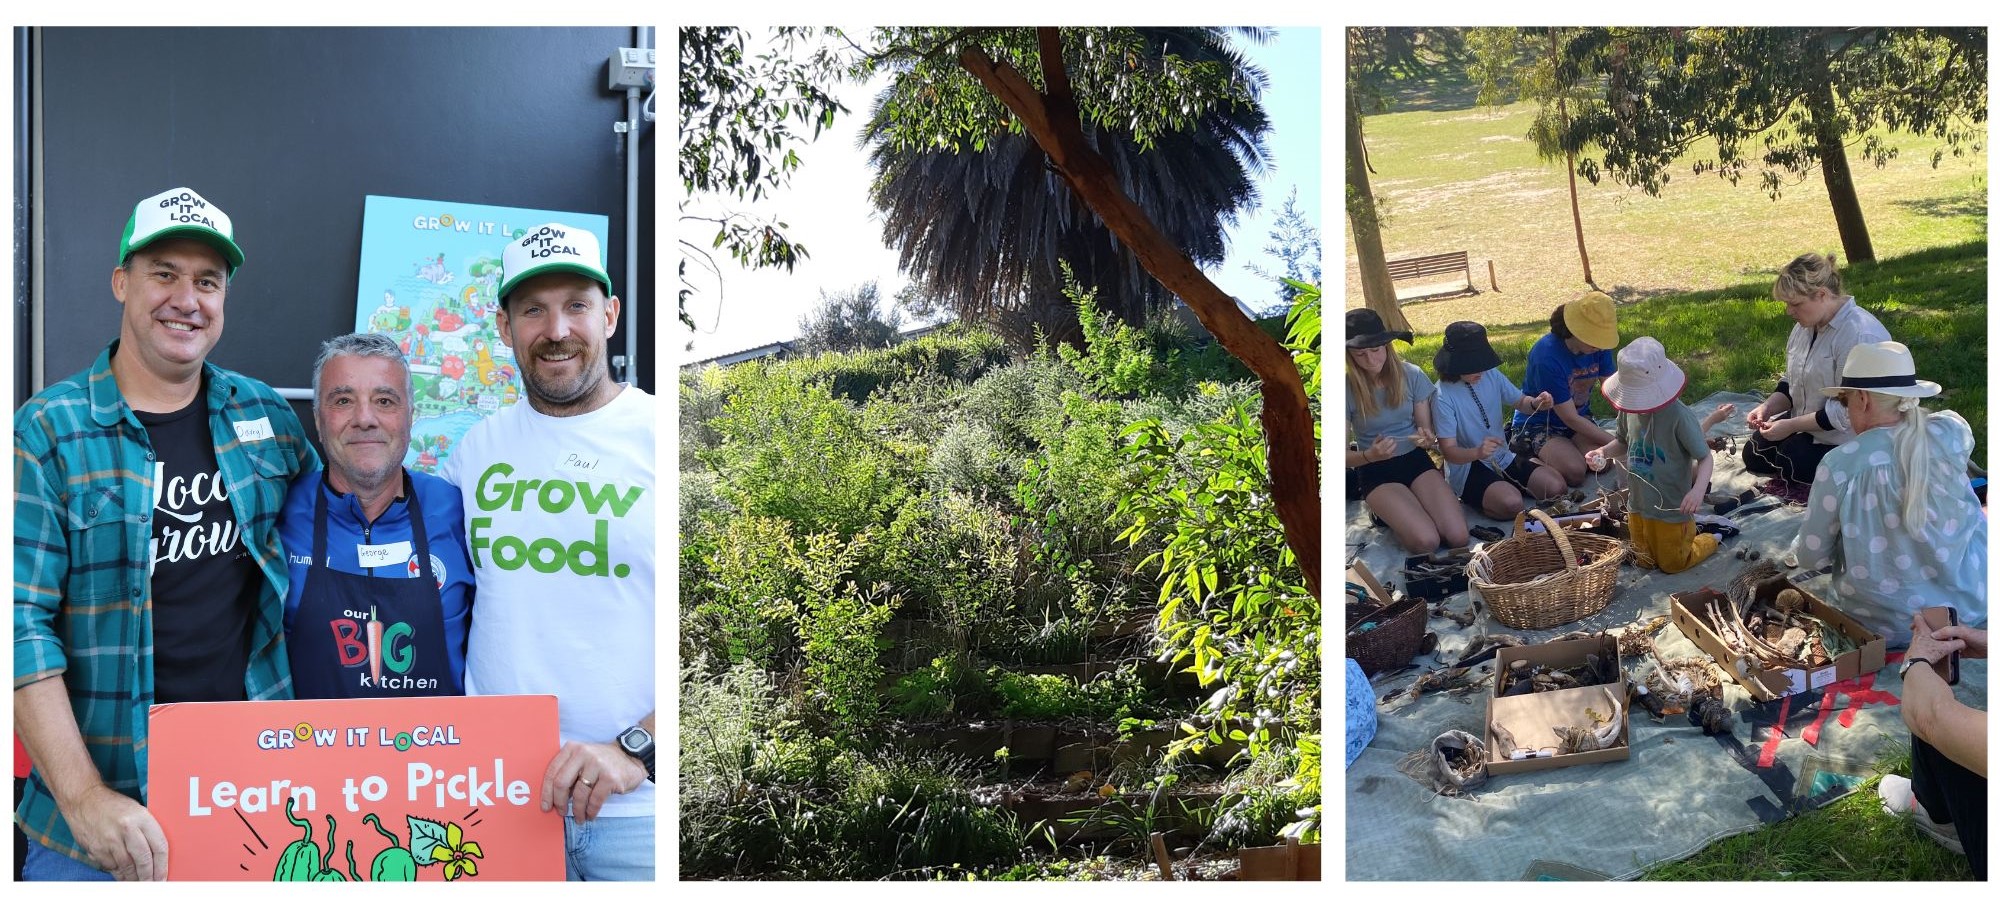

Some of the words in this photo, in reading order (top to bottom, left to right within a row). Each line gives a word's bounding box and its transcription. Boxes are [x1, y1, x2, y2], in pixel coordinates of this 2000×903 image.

[160, 192, 206, 209] GROW
[179, 204, 194, 214] IT
[170, 212, 218, 231] LOCAL
[413, 213, 472, 232] GROW
[478, 221, 496, 236] IT
[521, 226, 566, 247] GROW
[539, 237, 554, 248] IT
[531, 245, 581, 259] LOCAL
[563, 453, 600, 471] Paul
[475, 462, 646, 518] Grow
[360, 547, 390, 561] George
[469, 517, 631, 579] Food.
[343, 608, 370, 620] our
[257, 721, 338, 751] GROW
[345, 726, 370, 748] IT
[378, 725, 461, 752] LOCAL
[188, 776, 317, 817] Learn
[341, 773, 388, 812] to
[406, 757, 531, 808] Pickle
